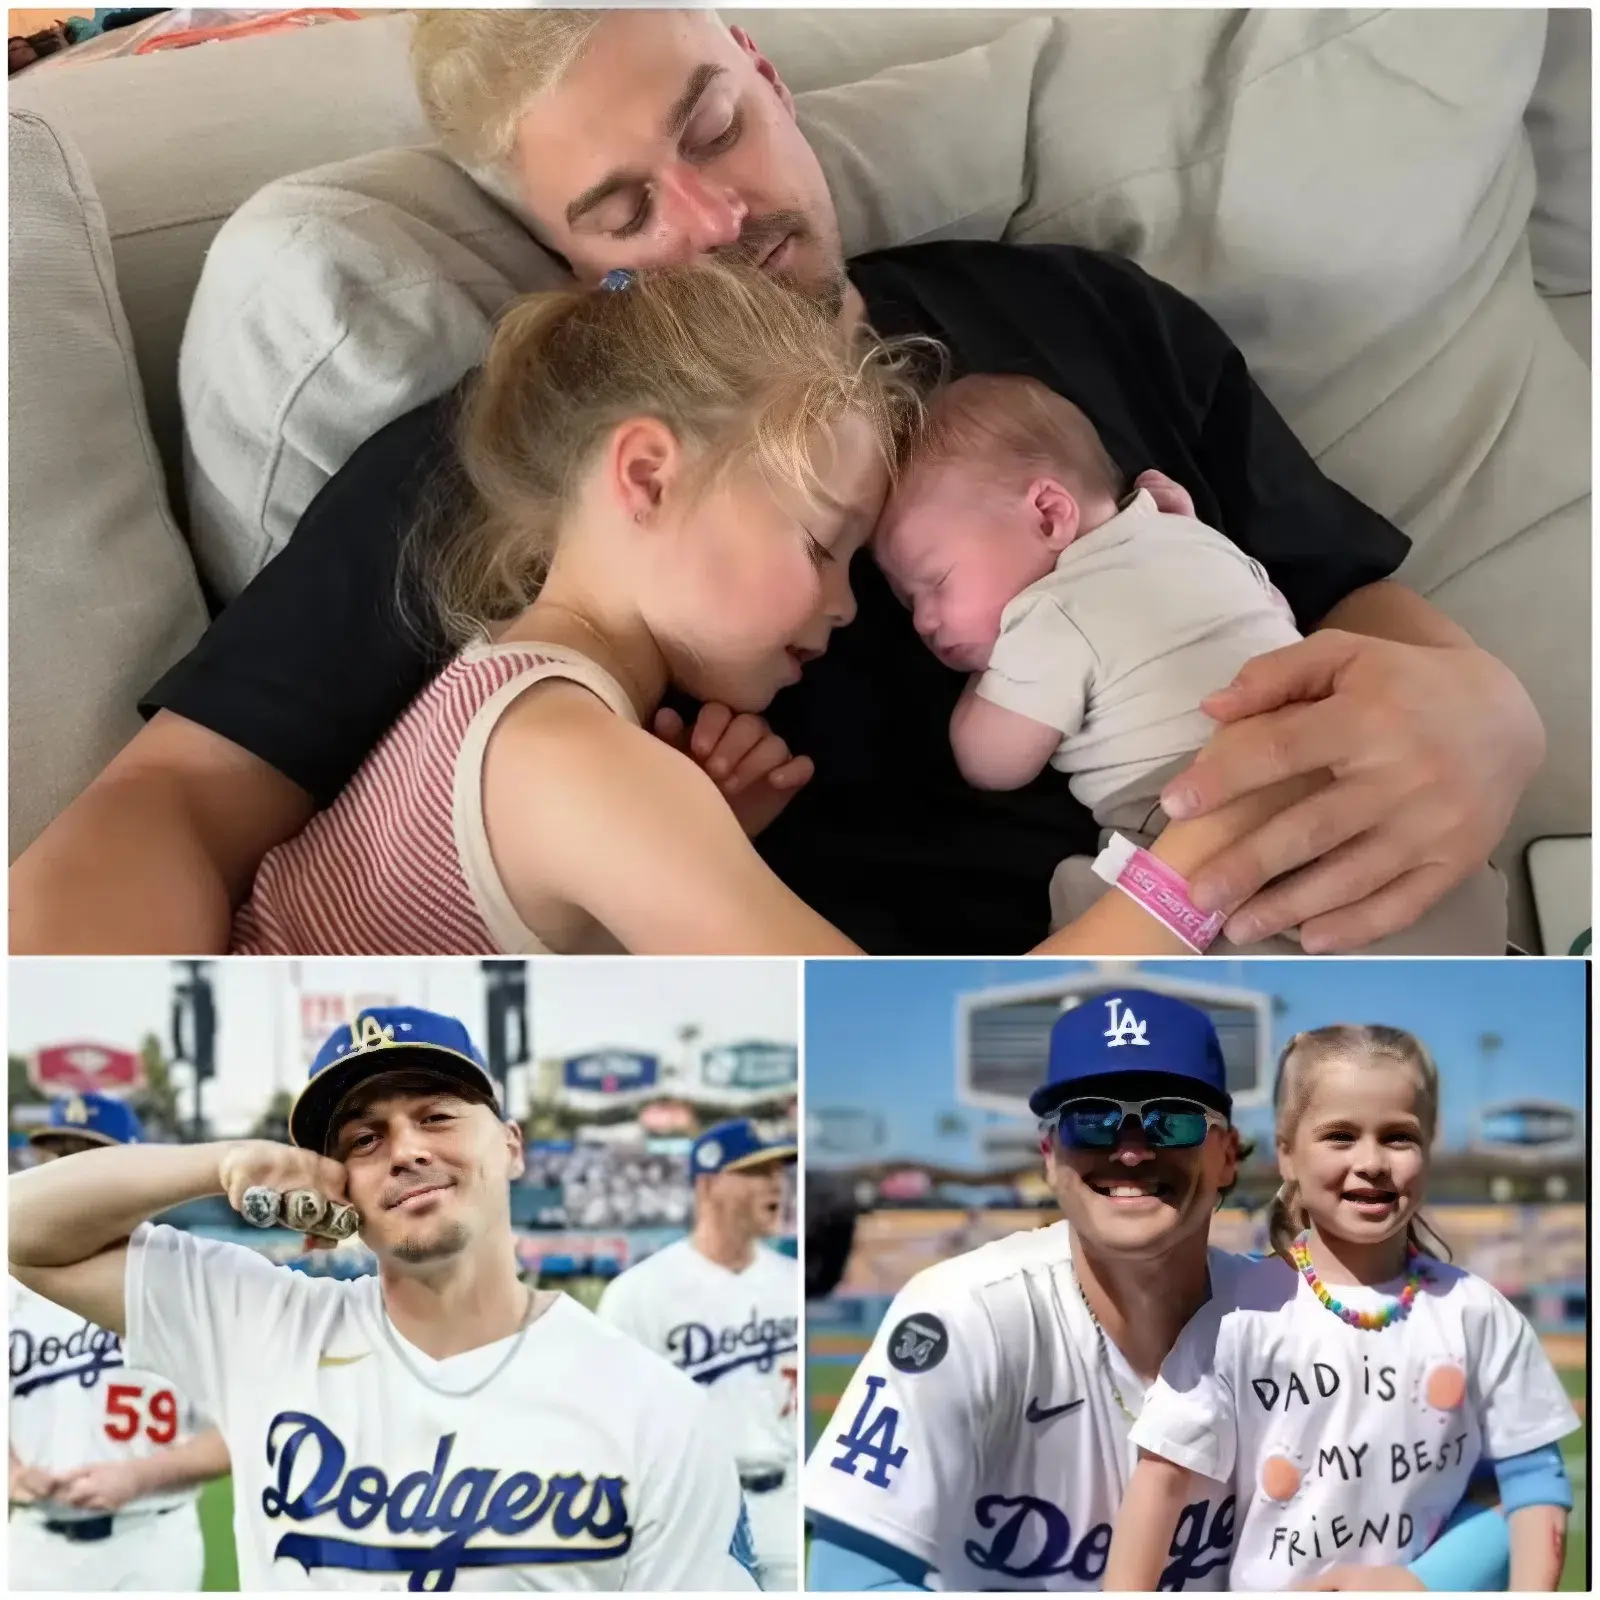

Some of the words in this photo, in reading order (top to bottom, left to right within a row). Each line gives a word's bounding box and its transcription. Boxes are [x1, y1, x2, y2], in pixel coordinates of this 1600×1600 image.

[1103, 998, 1151, 1048] LA
[894, 1330, 935, 1368] 34
[1251, 1362, 1341, 1412] DAD
[104, 1384, 178, 1445] 59
[830, 1375, 909, 1490] LA
[1318, 1442, 1369, 1481] MY
[1391, 1433, 1468, 1484] BEST
[262, 1411, 628, 1592] Dodgers
